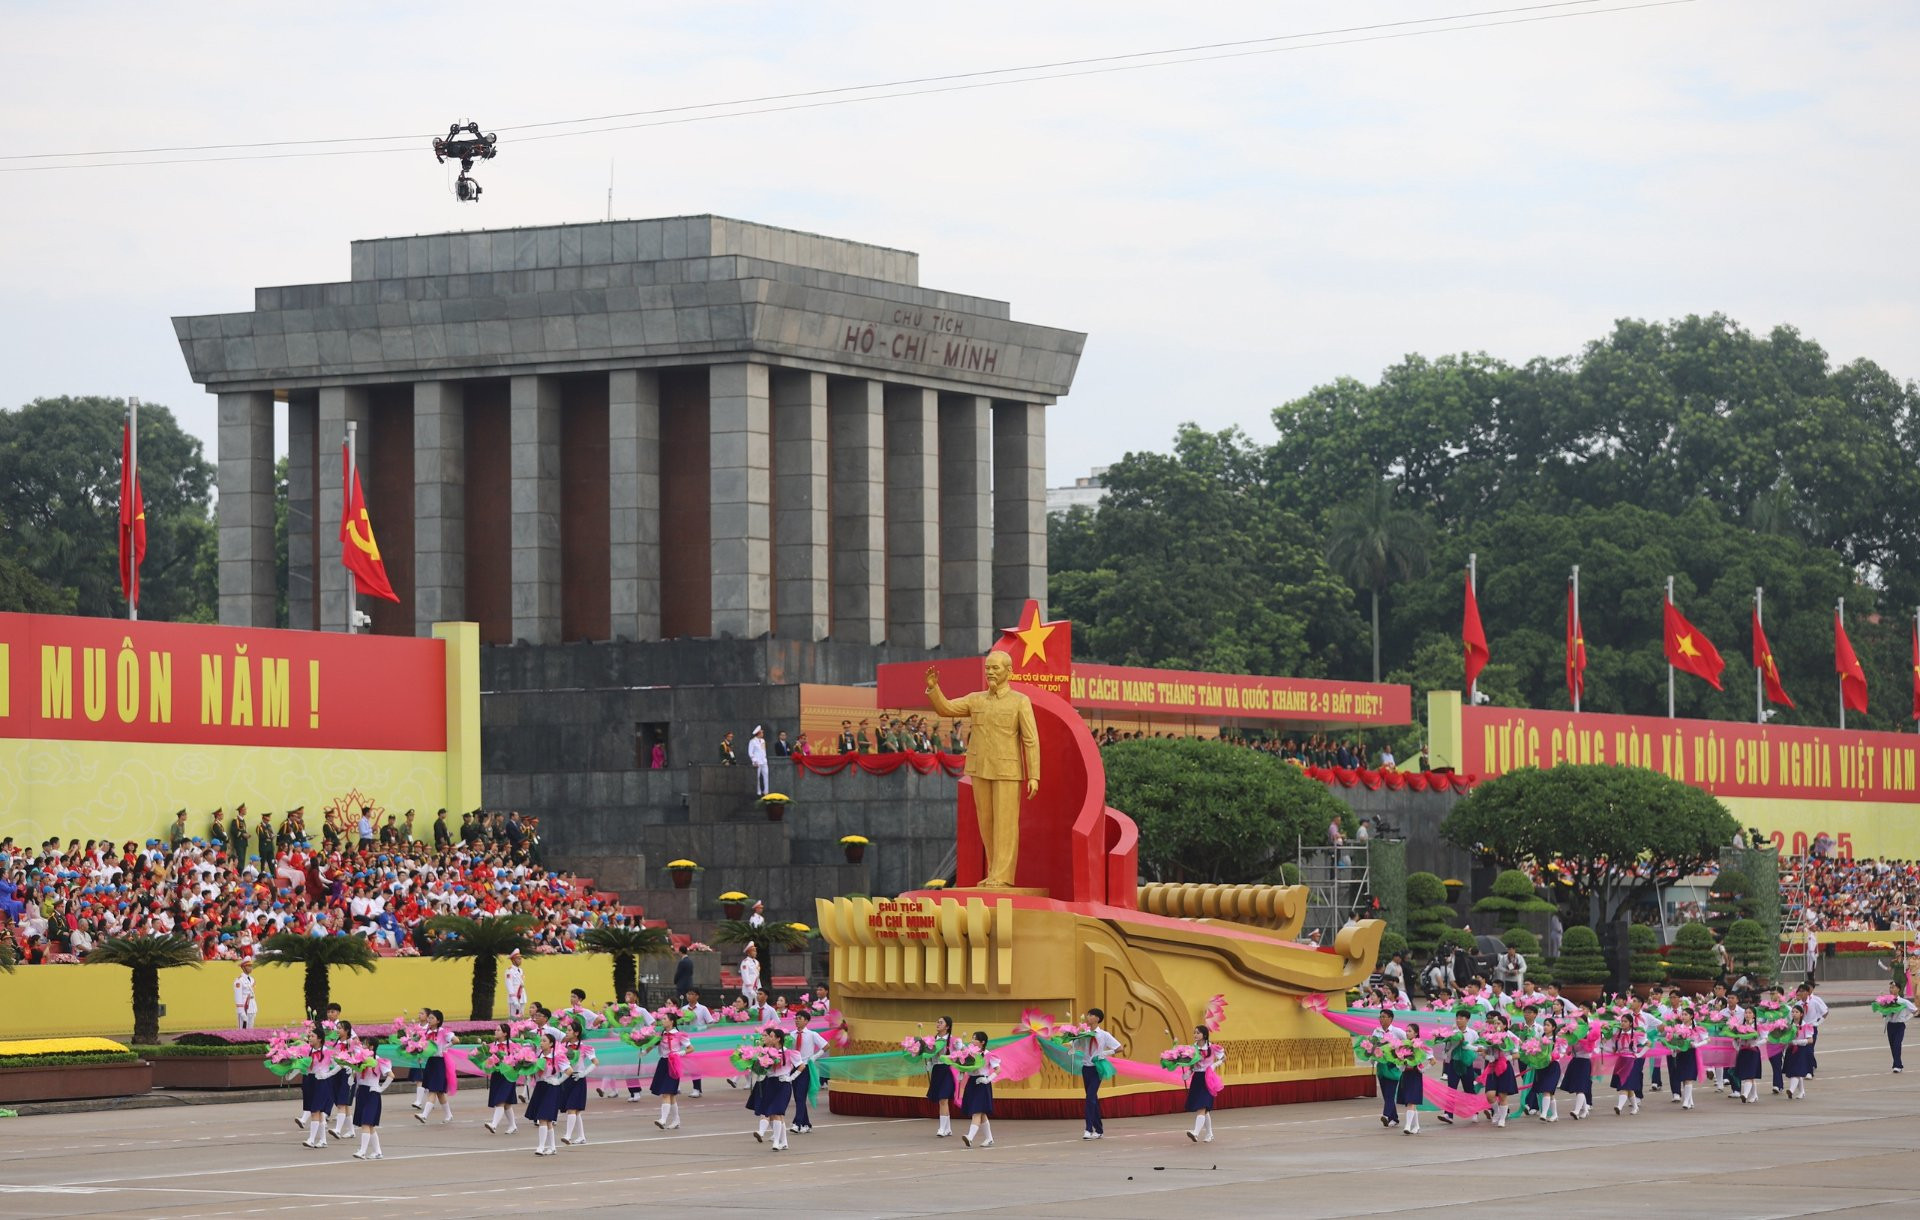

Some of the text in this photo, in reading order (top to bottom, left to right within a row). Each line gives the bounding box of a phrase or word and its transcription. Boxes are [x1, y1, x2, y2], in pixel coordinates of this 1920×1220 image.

[42, 636, 171, 723] MUÔN
[201, 643, 289, 728] NĂM
[309, 659, 319, 729] !
[1089, 674, 1119, 700] CÁCH
[1122, 680, 1155, 707] MẠNG
[1158, 680, 1195, 705] THÁNG
[1198, 682, 1222, 707] TÁM
[1225, 683, 1239, 708] VÀ
[1241, 683, 1269, 711] QUỐC
[1272, 686, 1308, 712] KHÁNH
[1332, 688, 1353, 714] BẤT
[1484, 718, 1540, 775] NƯỚC
[1615, 725, 1651, 769] HÒA
[1662, 728, 1685, 782] XÃ
[1694, 729, 1726, 791] HỘI
[1735, 729, 1770, 786] CHỦ
[1779, 736, 1831, 788] NGHĨA
[1839, 738, 1875, 798] VIỆT
[1882, 748, 1916, 791] NAM
[1770, 830, 1853, 862] 205
[868, 911, 935, 929] HỒ CHÍ MINH
[879, 900, 923, 914] CHỦ TỊCH
